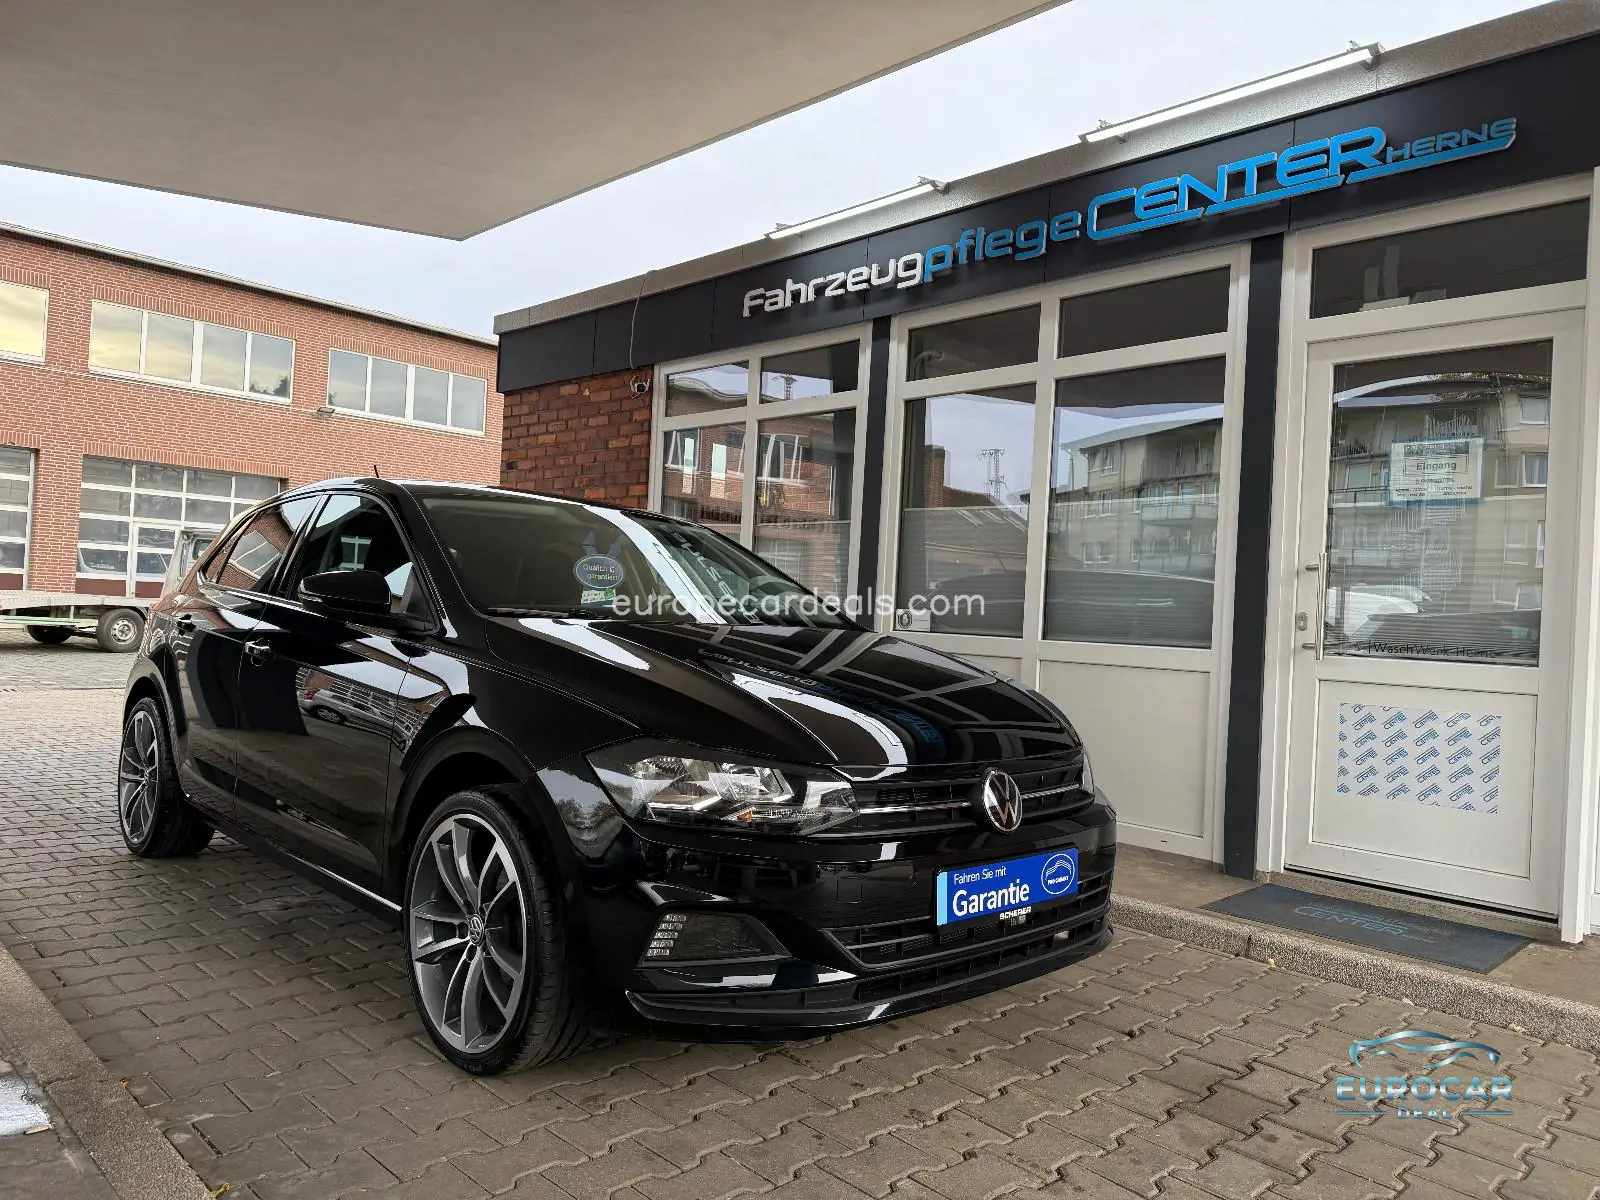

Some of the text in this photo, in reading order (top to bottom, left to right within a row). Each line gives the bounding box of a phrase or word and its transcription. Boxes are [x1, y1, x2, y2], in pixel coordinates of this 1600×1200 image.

[1386, 117, 1516, 164] HERNE
[1416, 461, 1457, 471] Eingang
[954, 865, 1007, 886] Fahren Sie mit
[952, 878, 1030, 917] Garantie
[999, 906, 1032, 920] SCHERER
[1294, 906, 1411, 936] CENTER
